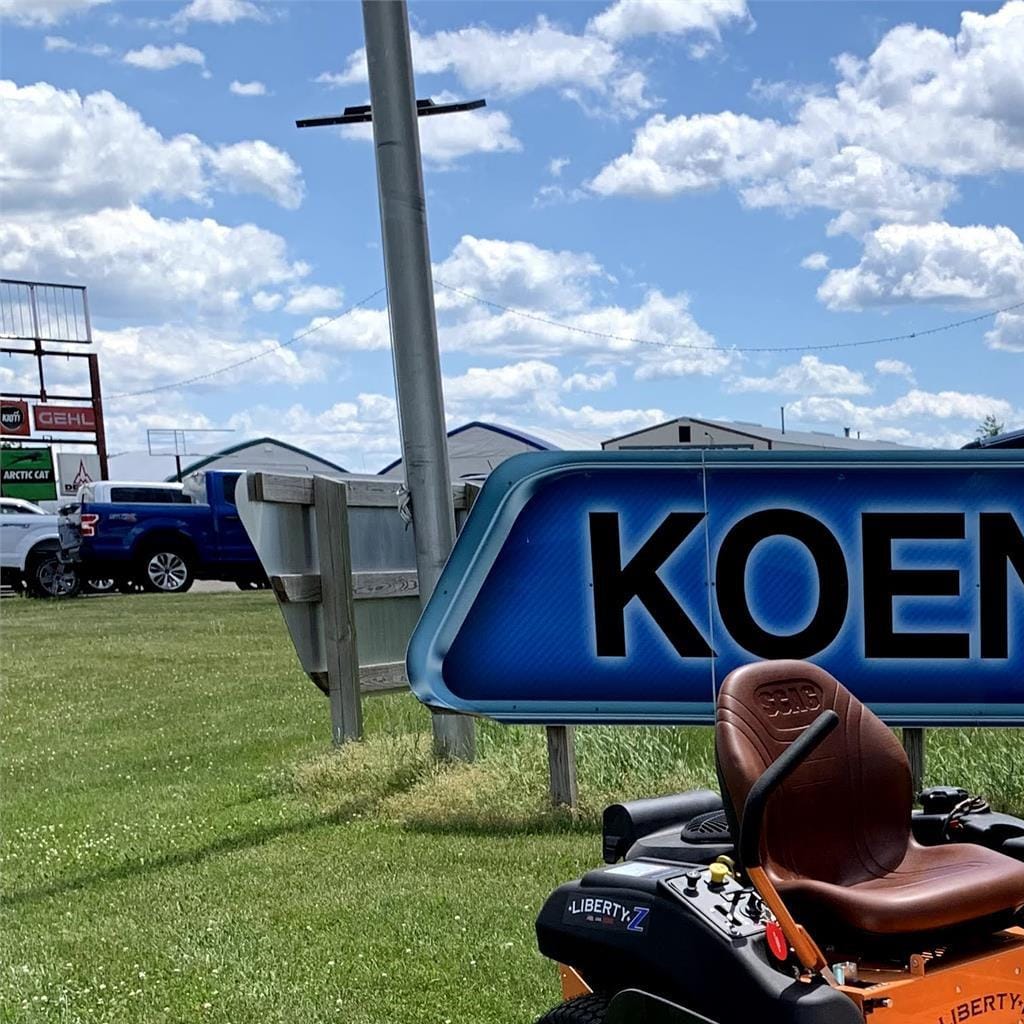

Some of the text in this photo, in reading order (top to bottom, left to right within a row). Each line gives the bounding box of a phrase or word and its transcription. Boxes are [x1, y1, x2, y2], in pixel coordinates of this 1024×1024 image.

[39, 412, 94, 425] GEHL
[3, 470, 49, 480] ARCTIC CAT
[758, 685, 821, 717] SCAG
[572, 898, 650, 932] LIBERTY Z
